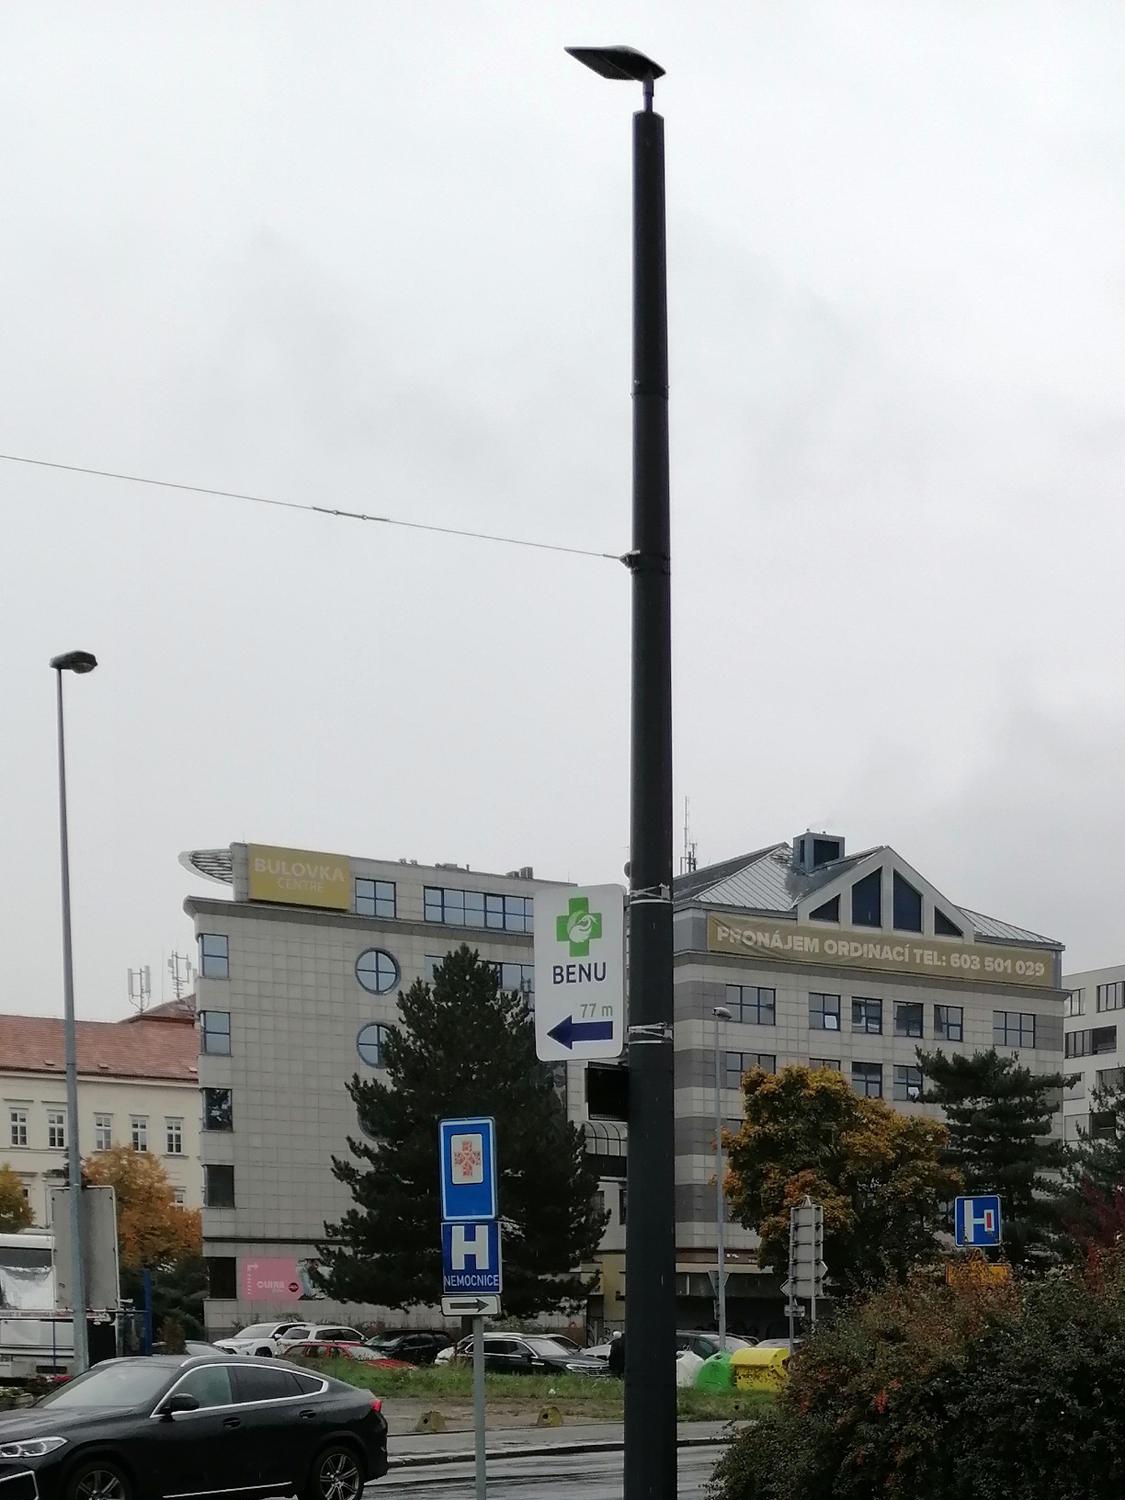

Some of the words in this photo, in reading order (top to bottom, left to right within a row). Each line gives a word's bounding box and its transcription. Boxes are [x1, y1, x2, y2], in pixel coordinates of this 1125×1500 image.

[254, 857, 345, 882] BULOVKA
[276, 876, 324, 893] CENTRE
[716, 925, 819, 953] PRONÁJEM
[823, 939, 910, 963] ORDINACÍ
[913, 947, 947, 967] TEL:
[949, 953, 981, 970] 603
[984, 956, 1012, 974] 501
[1015, 959, 1045, 977] 029
[552, 961, 607, 985] BENU
[580, 1002, 597, 1018] 77
[601, 1004, 613, 1017] m
[451, 1225, 490, 1270] H
[443, 1274, 500, 1288] NEMOCNICE
